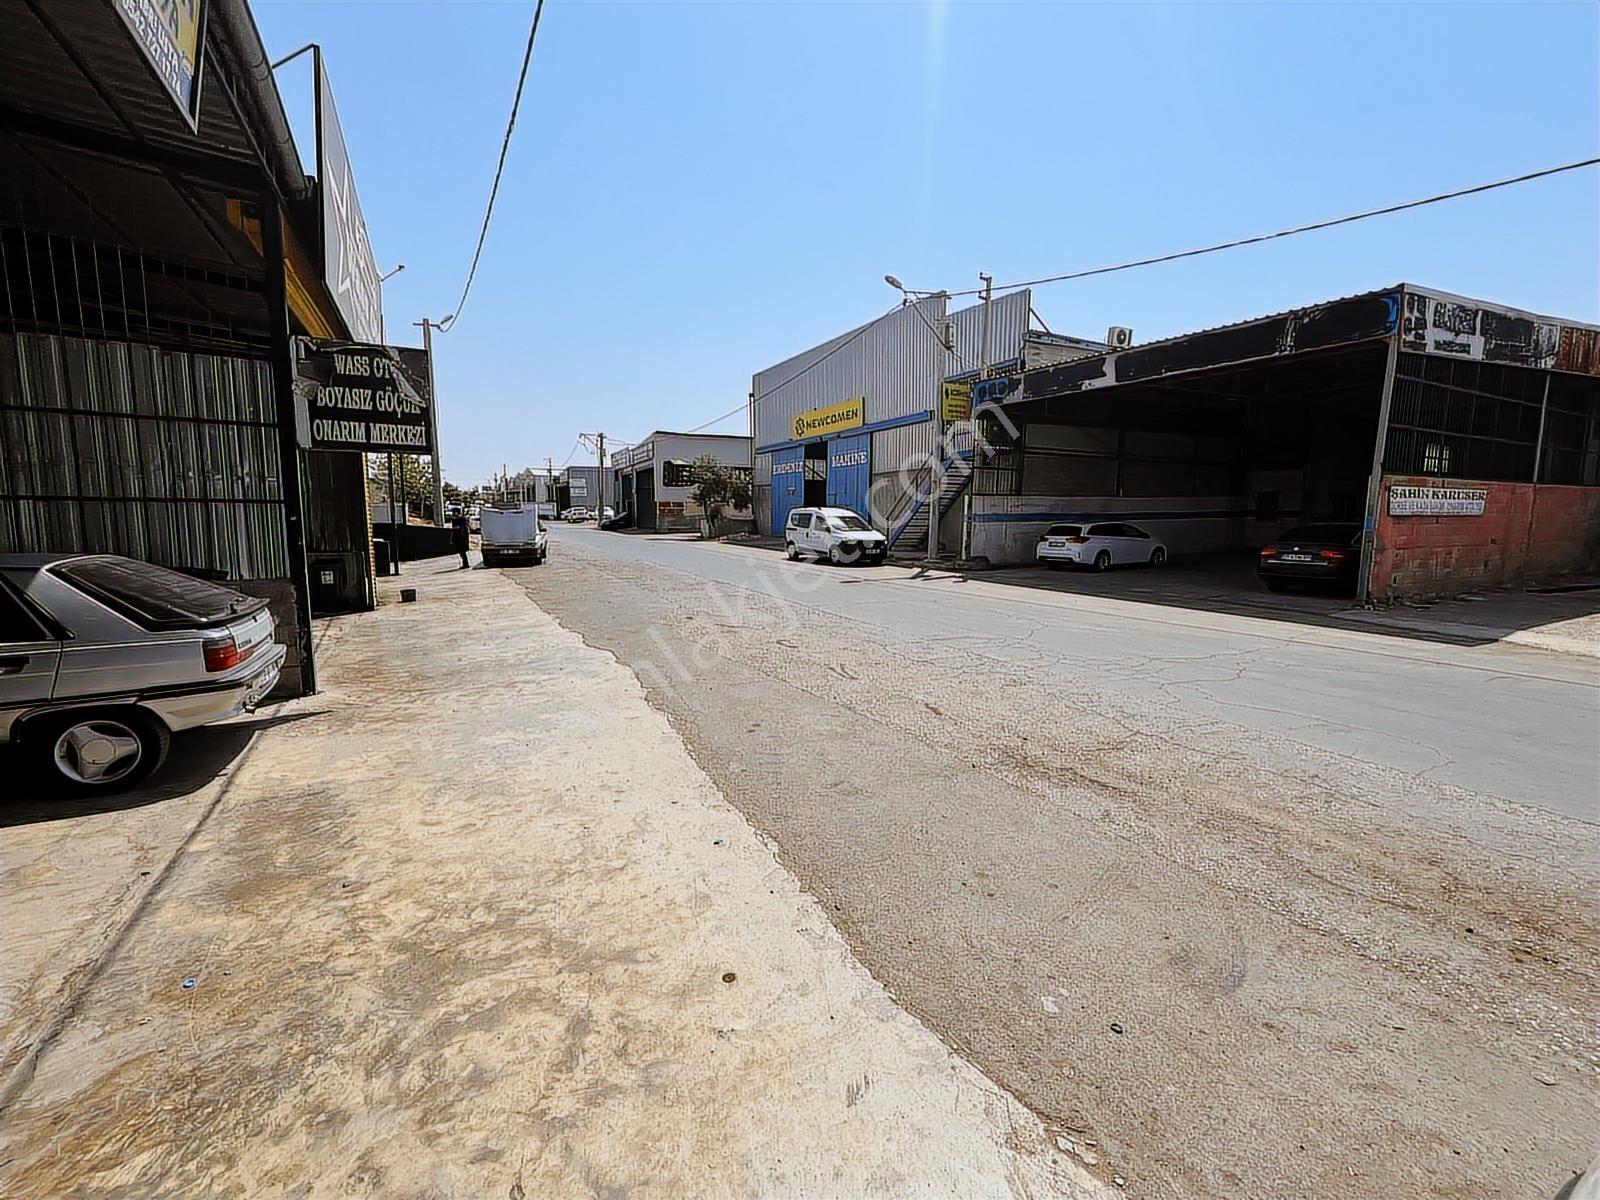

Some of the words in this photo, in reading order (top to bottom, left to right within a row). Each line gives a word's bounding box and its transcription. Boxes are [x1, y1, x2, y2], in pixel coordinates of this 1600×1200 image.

[373, 357, 393, 379] OT
[317, 386, 373, 410] BOYASIZ
[805, 407, 859, 430] NEWCOMEN
[313, 418, 366, 443] ONARIM
[369, 421, 426, 446] MERKEZİ
